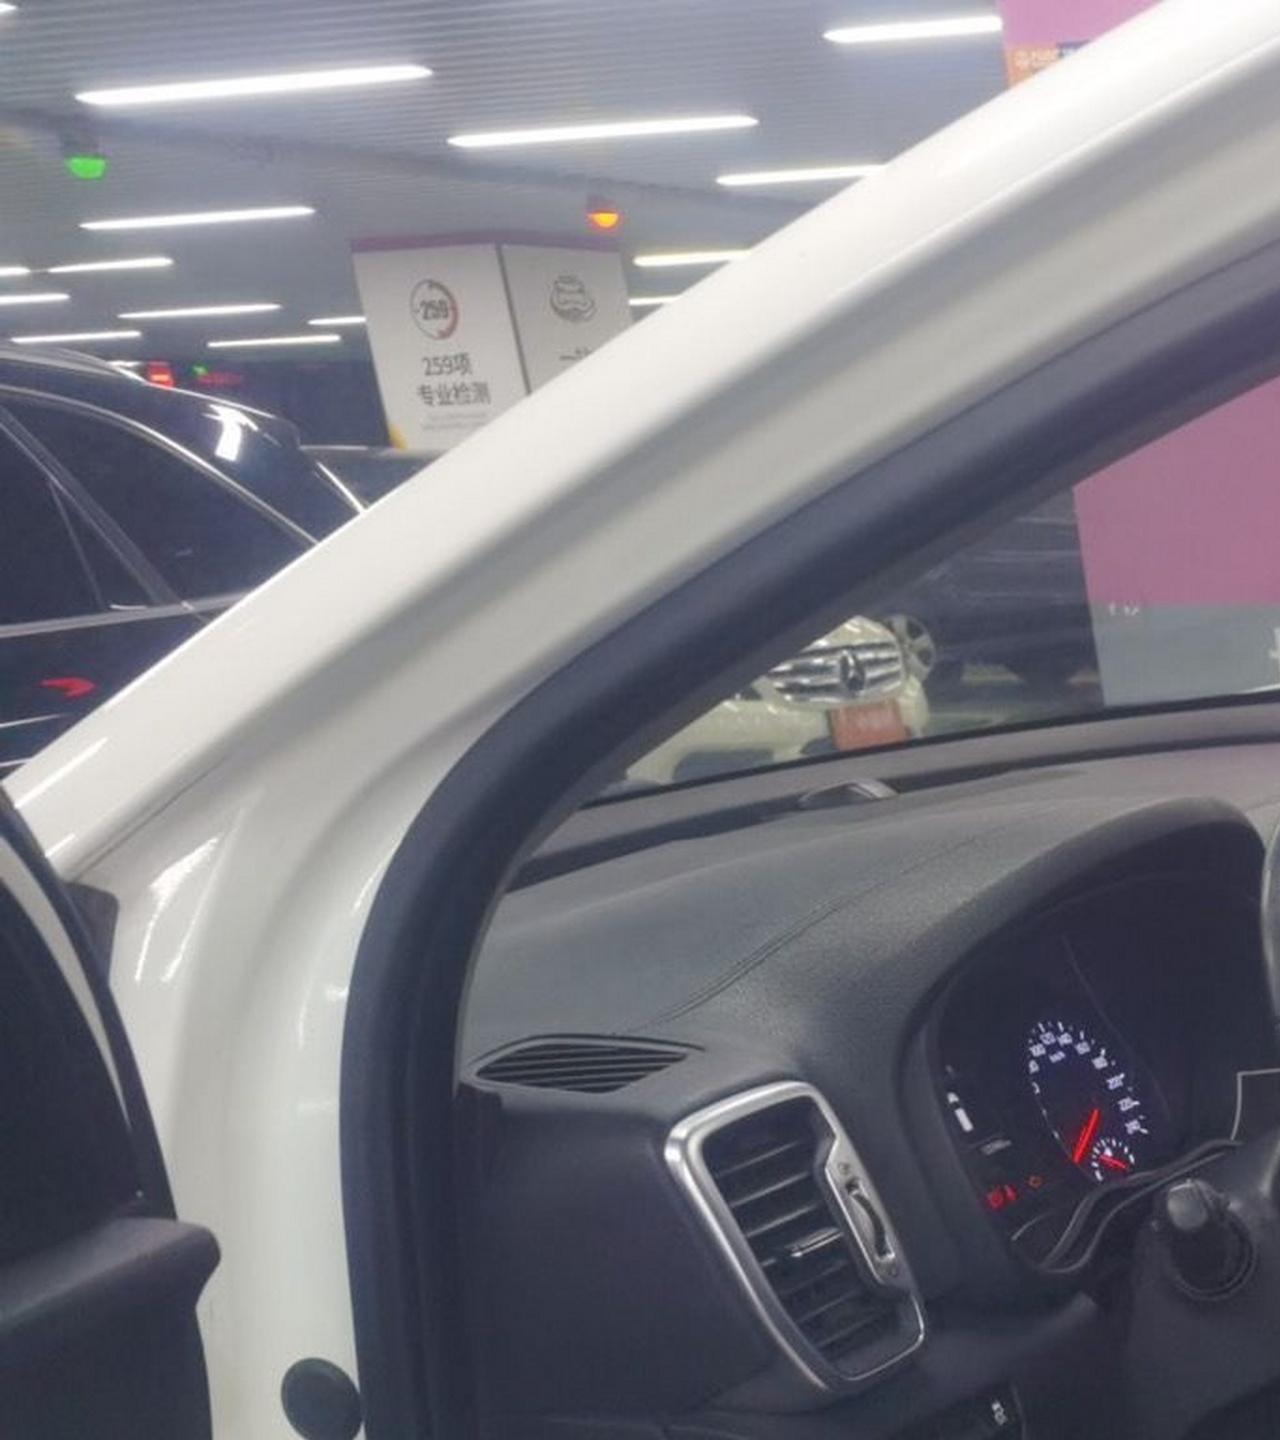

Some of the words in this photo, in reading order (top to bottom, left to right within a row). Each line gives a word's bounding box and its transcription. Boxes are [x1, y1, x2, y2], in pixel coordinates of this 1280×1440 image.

[420, 300, 449, 321] 259
[421, 353, 472, 376] 259项
[417, 382, 491, 406] 专业检测
